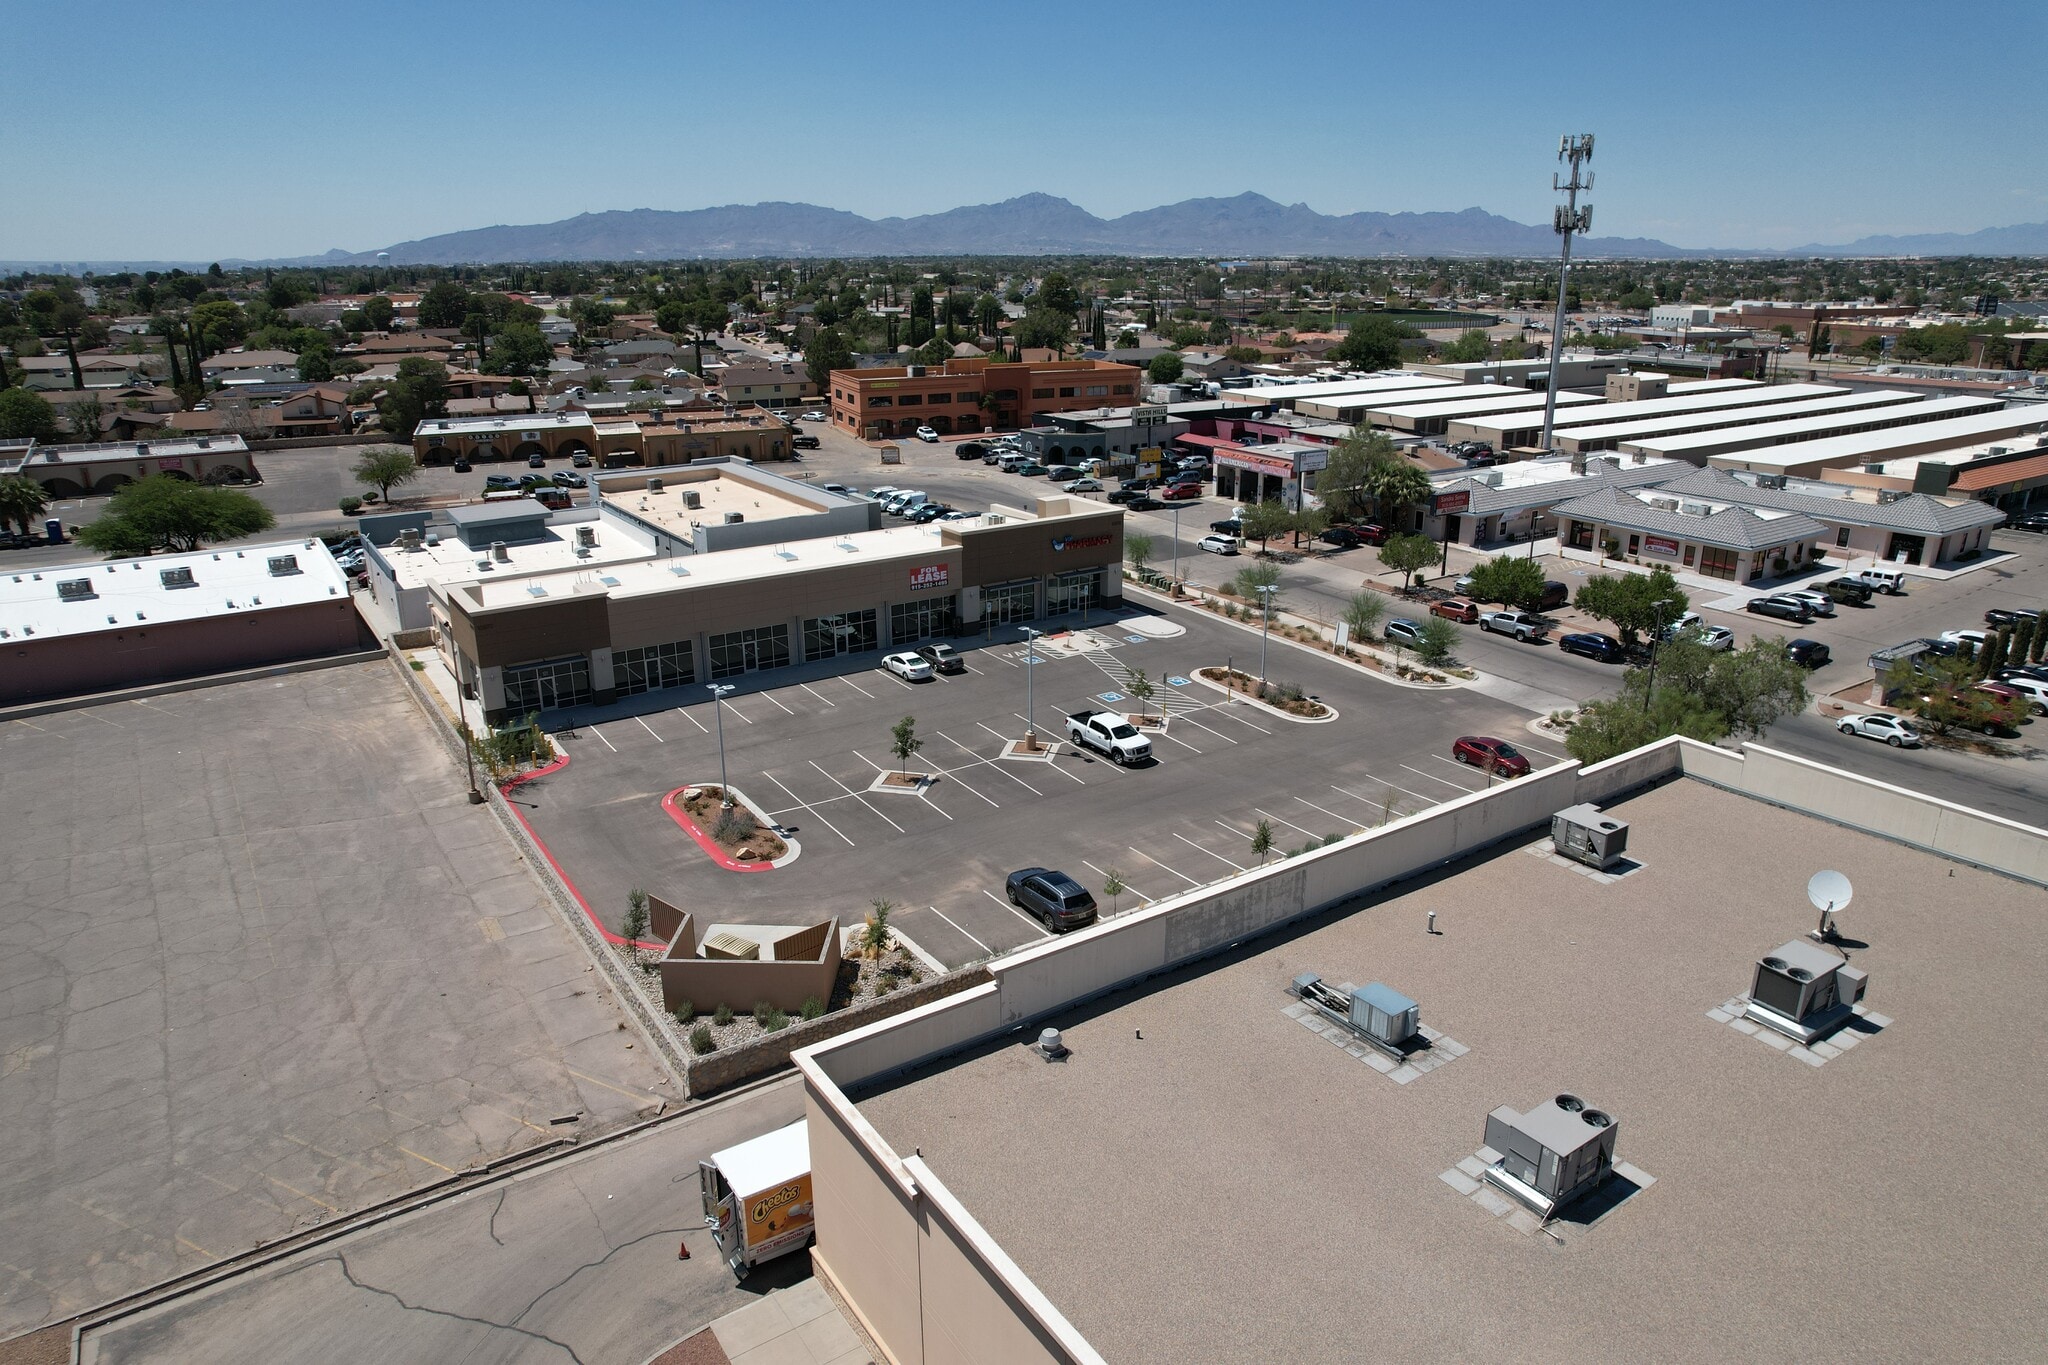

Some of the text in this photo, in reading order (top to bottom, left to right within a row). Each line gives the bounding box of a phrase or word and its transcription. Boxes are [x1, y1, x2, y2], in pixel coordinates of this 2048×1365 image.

[1137, 408, 1167, 418] VISTA HILLS
[1065, 535, 1113, 550] PHARMACY
[910, 570, 948, 585] LEASE
[920, 566, 938, 575] FOR
[753, 1186, 799, 1222] Cheetos
[756, 1230, 806, 1254] ZERO EMISSIONS
